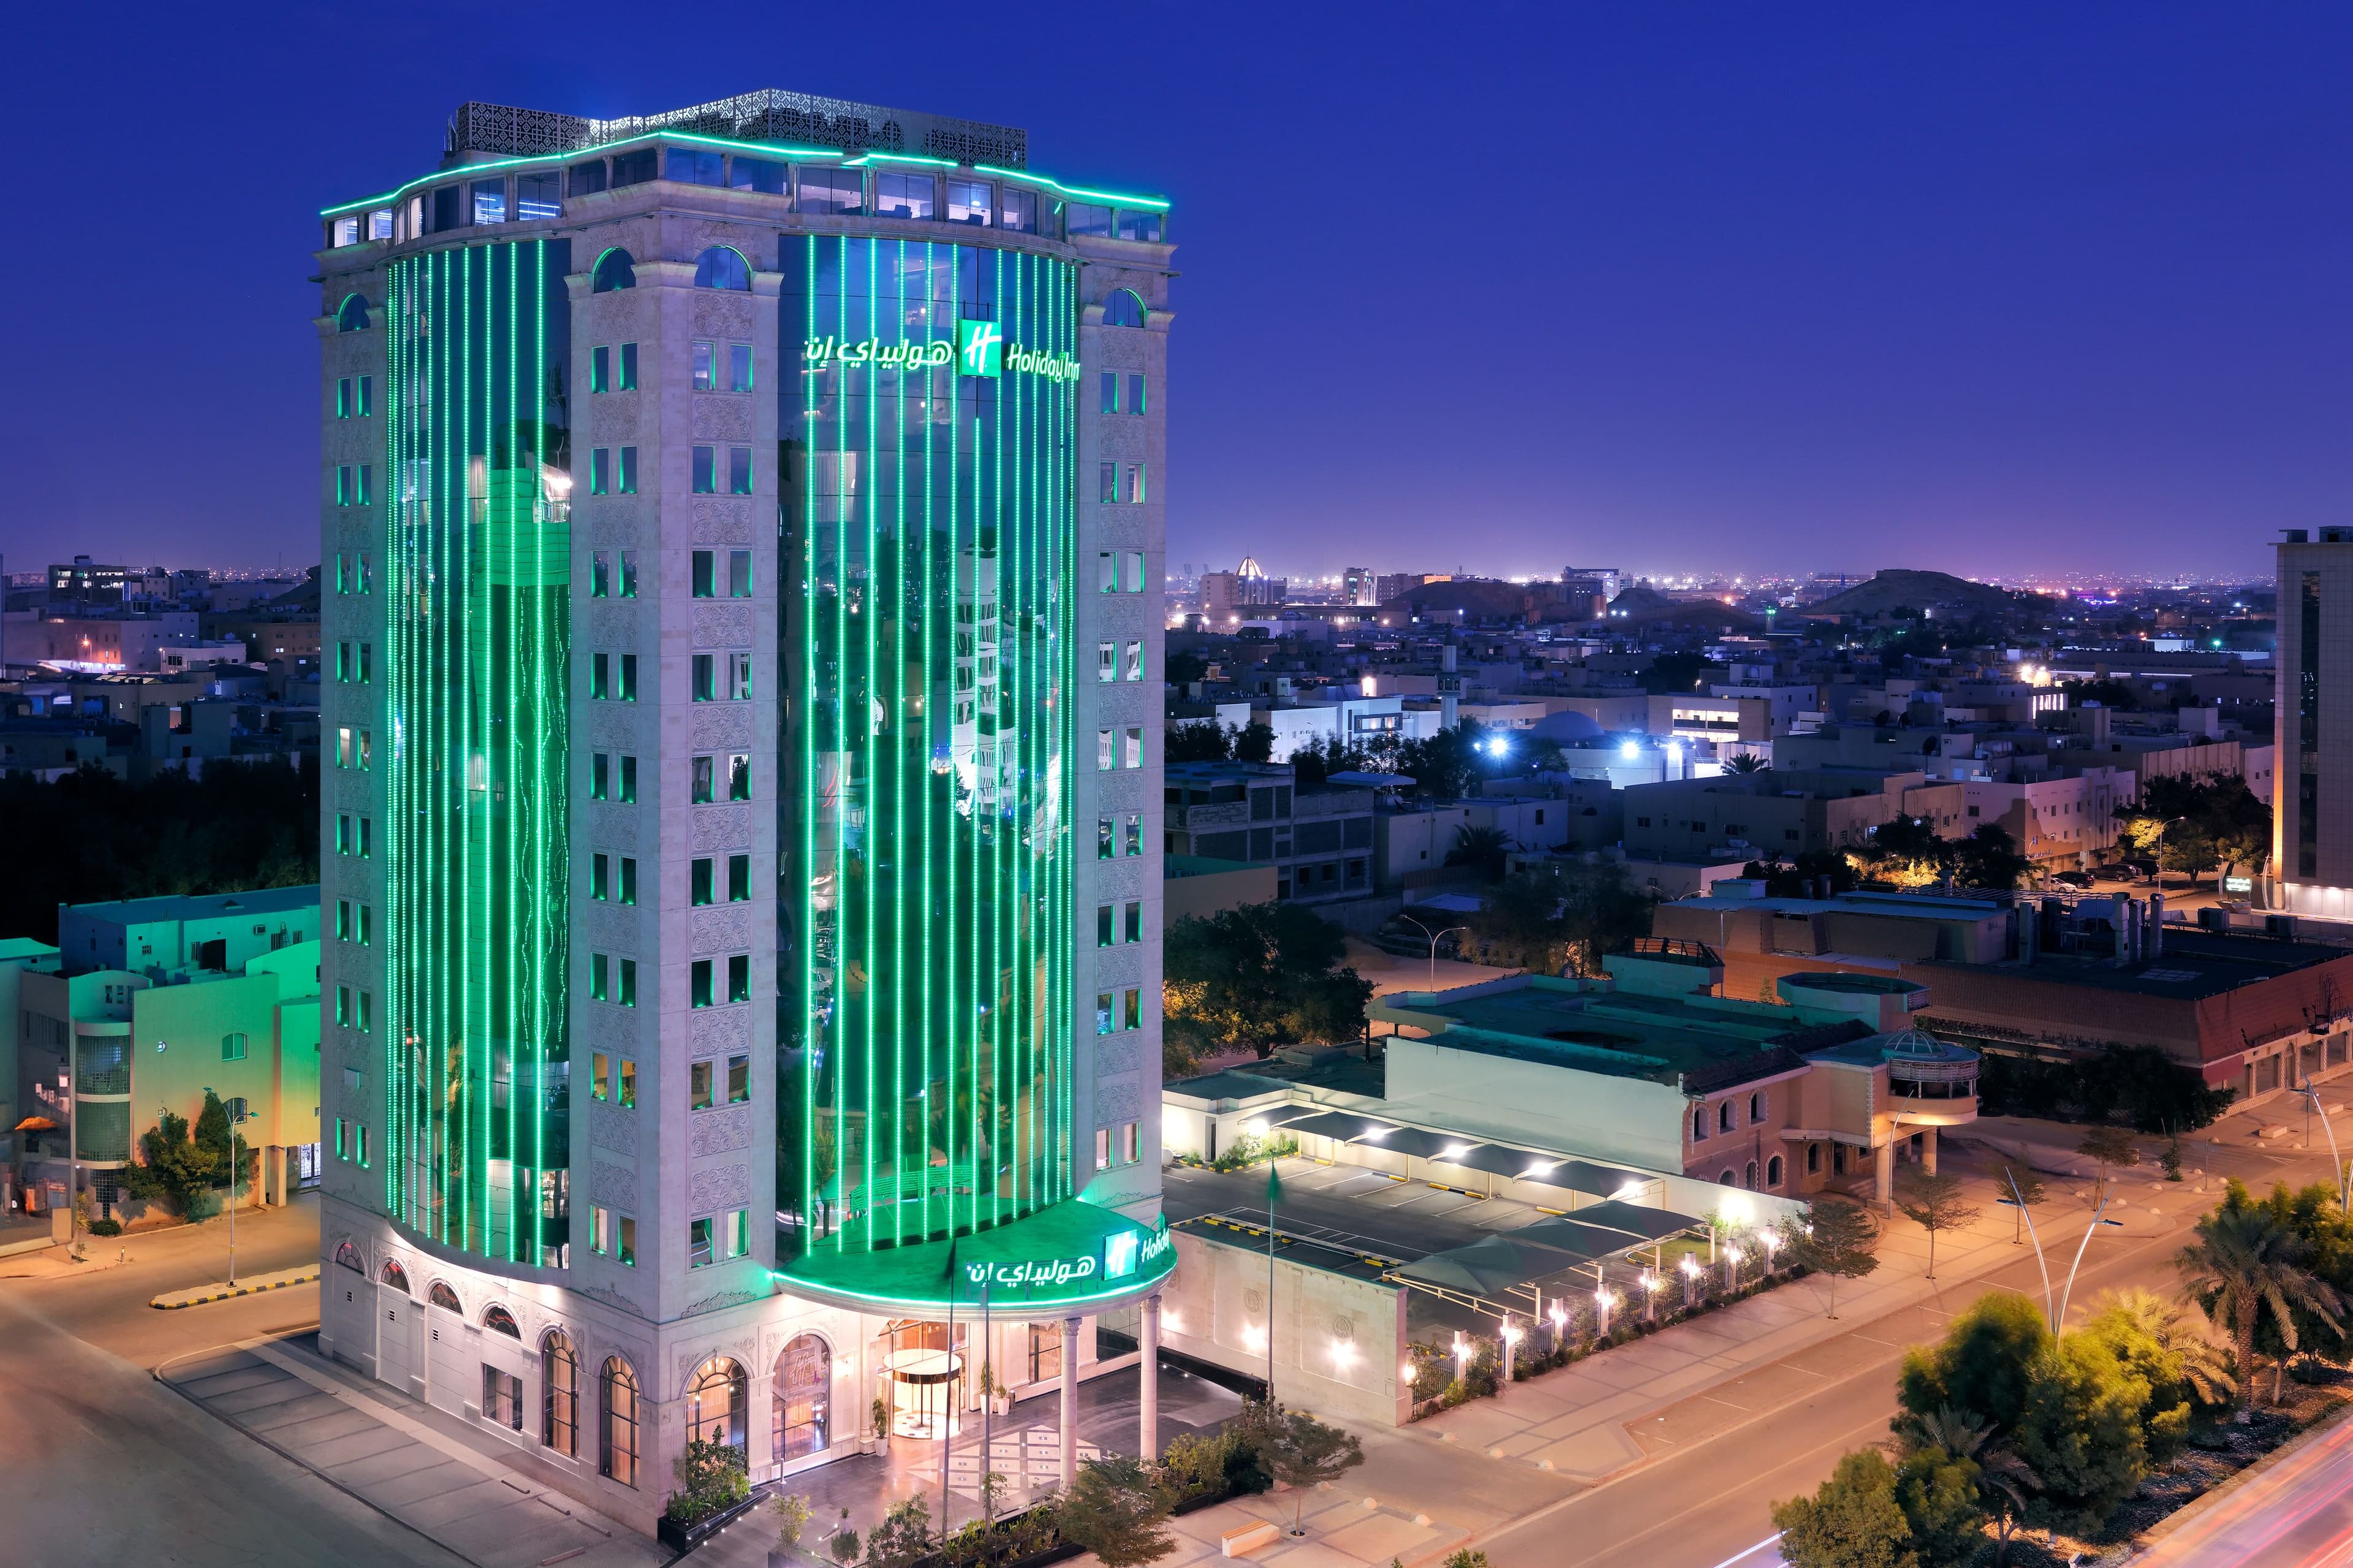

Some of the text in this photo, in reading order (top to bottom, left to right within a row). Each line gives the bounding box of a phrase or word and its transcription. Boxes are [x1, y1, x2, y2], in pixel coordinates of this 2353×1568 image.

[837, 336, 952, 371] هوليداي
[1007, 343, 1080, 383] Holiday Inn
[1141, 1227, 1169, 1263] Holida
[996, 1256, 1096, 1287] هوليداي
